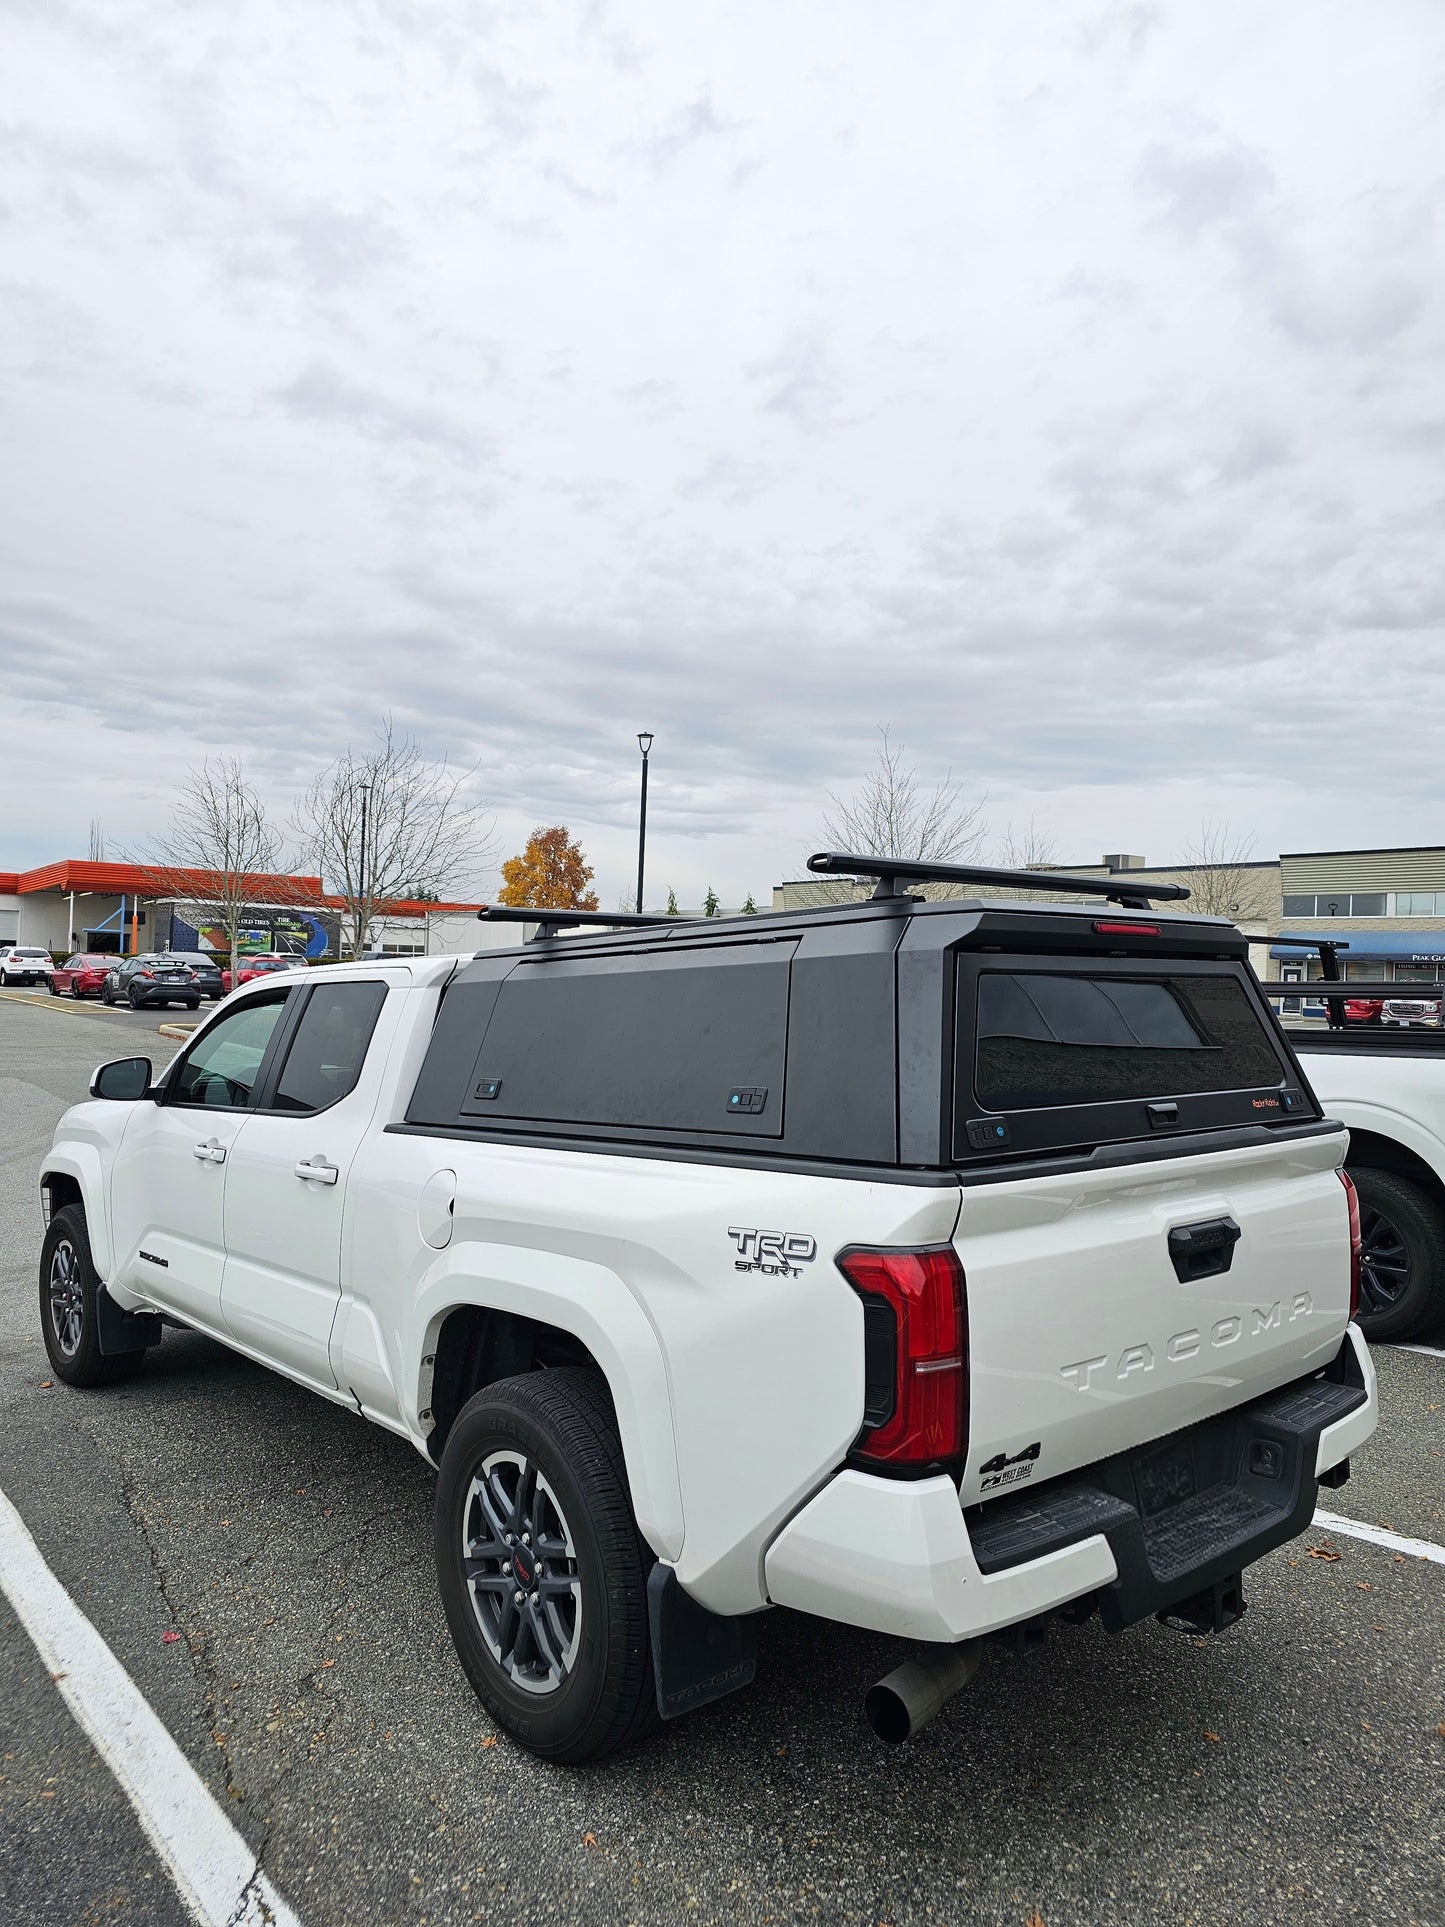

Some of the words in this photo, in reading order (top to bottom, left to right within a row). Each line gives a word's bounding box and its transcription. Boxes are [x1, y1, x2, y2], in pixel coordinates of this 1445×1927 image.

[727, 1225, 818, 1268] TRD
[734, 1260, 804, 1279] SPORT
[1060, 1290, 1313, 1392] TACOMA
[1003, 1468, 1017, 1479] WEST
[1017, 1463, 1034, 1475] COAST
[514, 1554, 530, 1582] TRD
